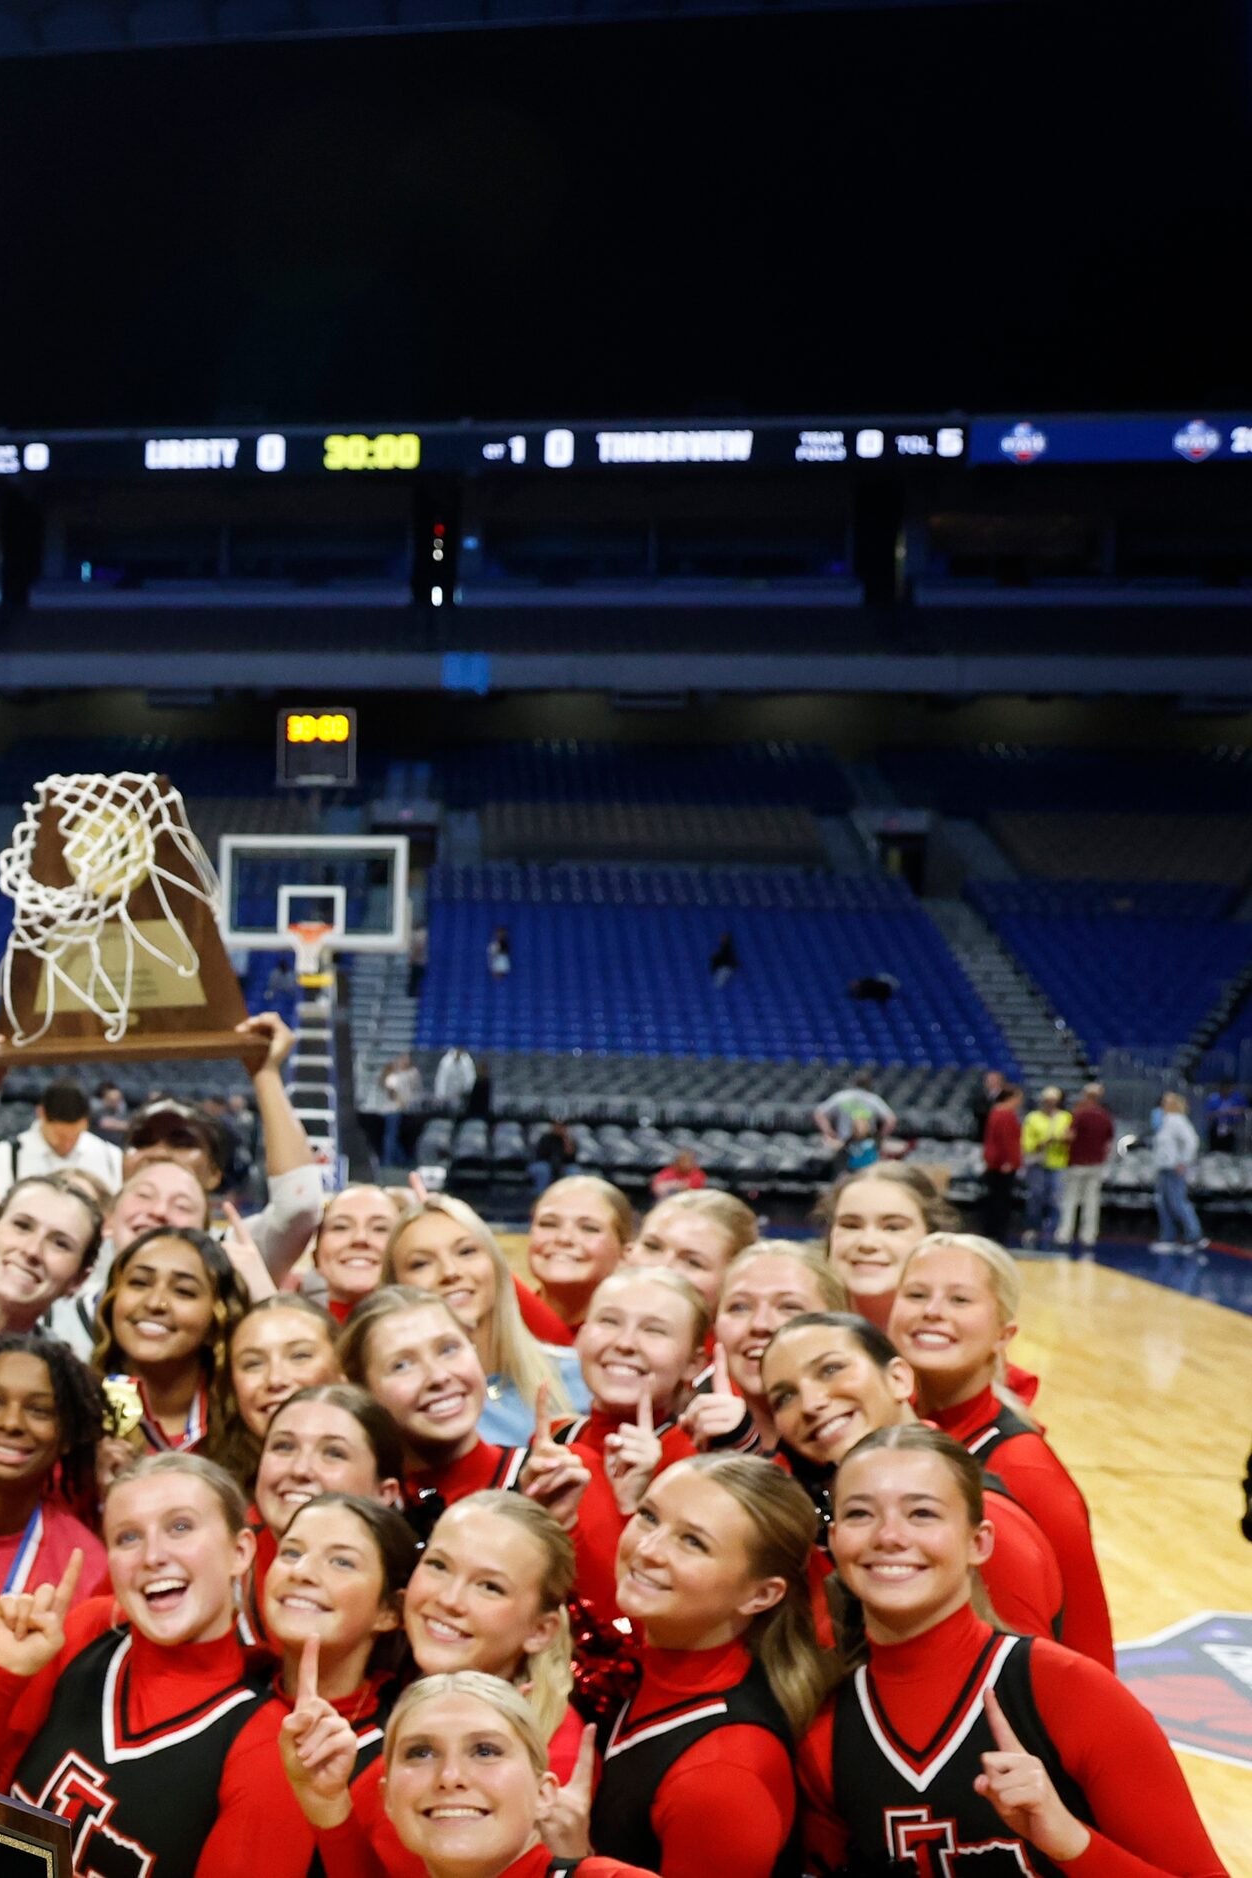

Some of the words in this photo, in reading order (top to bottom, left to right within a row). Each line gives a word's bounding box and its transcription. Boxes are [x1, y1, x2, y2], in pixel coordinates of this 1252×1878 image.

[24, 443, 49, 471] 0
[145, 438, 240, 469] LIBERTY
[256, 433, 286, 472] 0
[323, 434, 421, 470] 30:00
[544, 428, 574, 468] 0
[856, 429, 884, 458] 0
